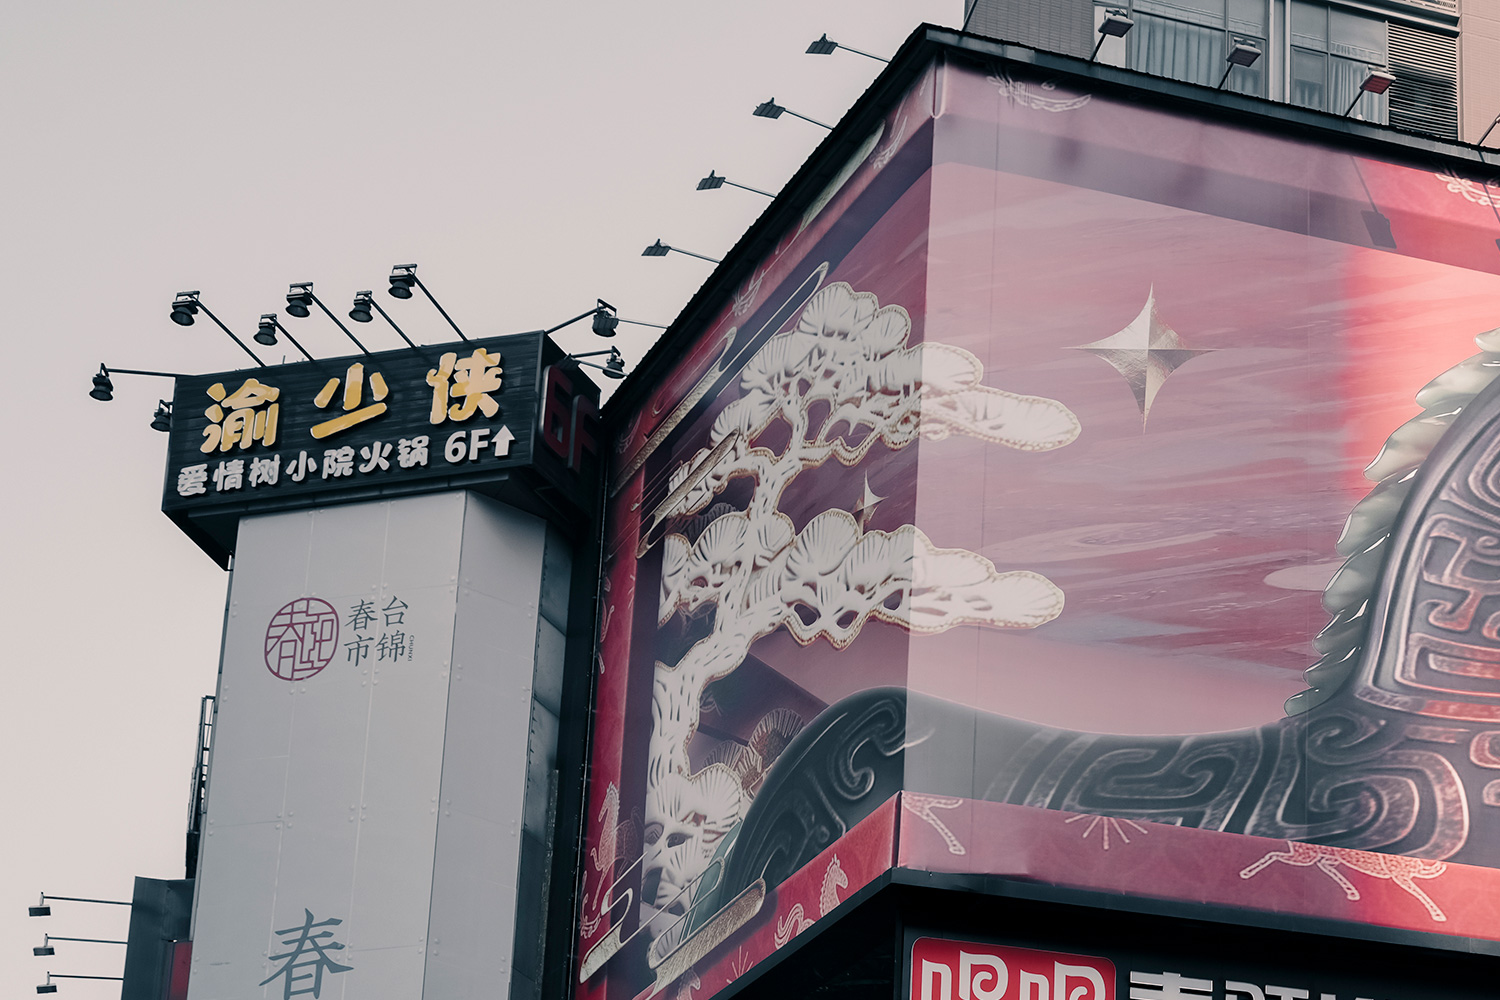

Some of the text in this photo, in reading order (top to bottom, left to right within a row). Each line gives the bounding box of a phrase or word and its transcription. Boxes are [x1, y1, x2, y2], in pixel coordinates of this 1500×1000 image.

[200, 347, 502, 454] 渝少侠
[177, 429, 491, 497] 爱情树小院火锅 6F
